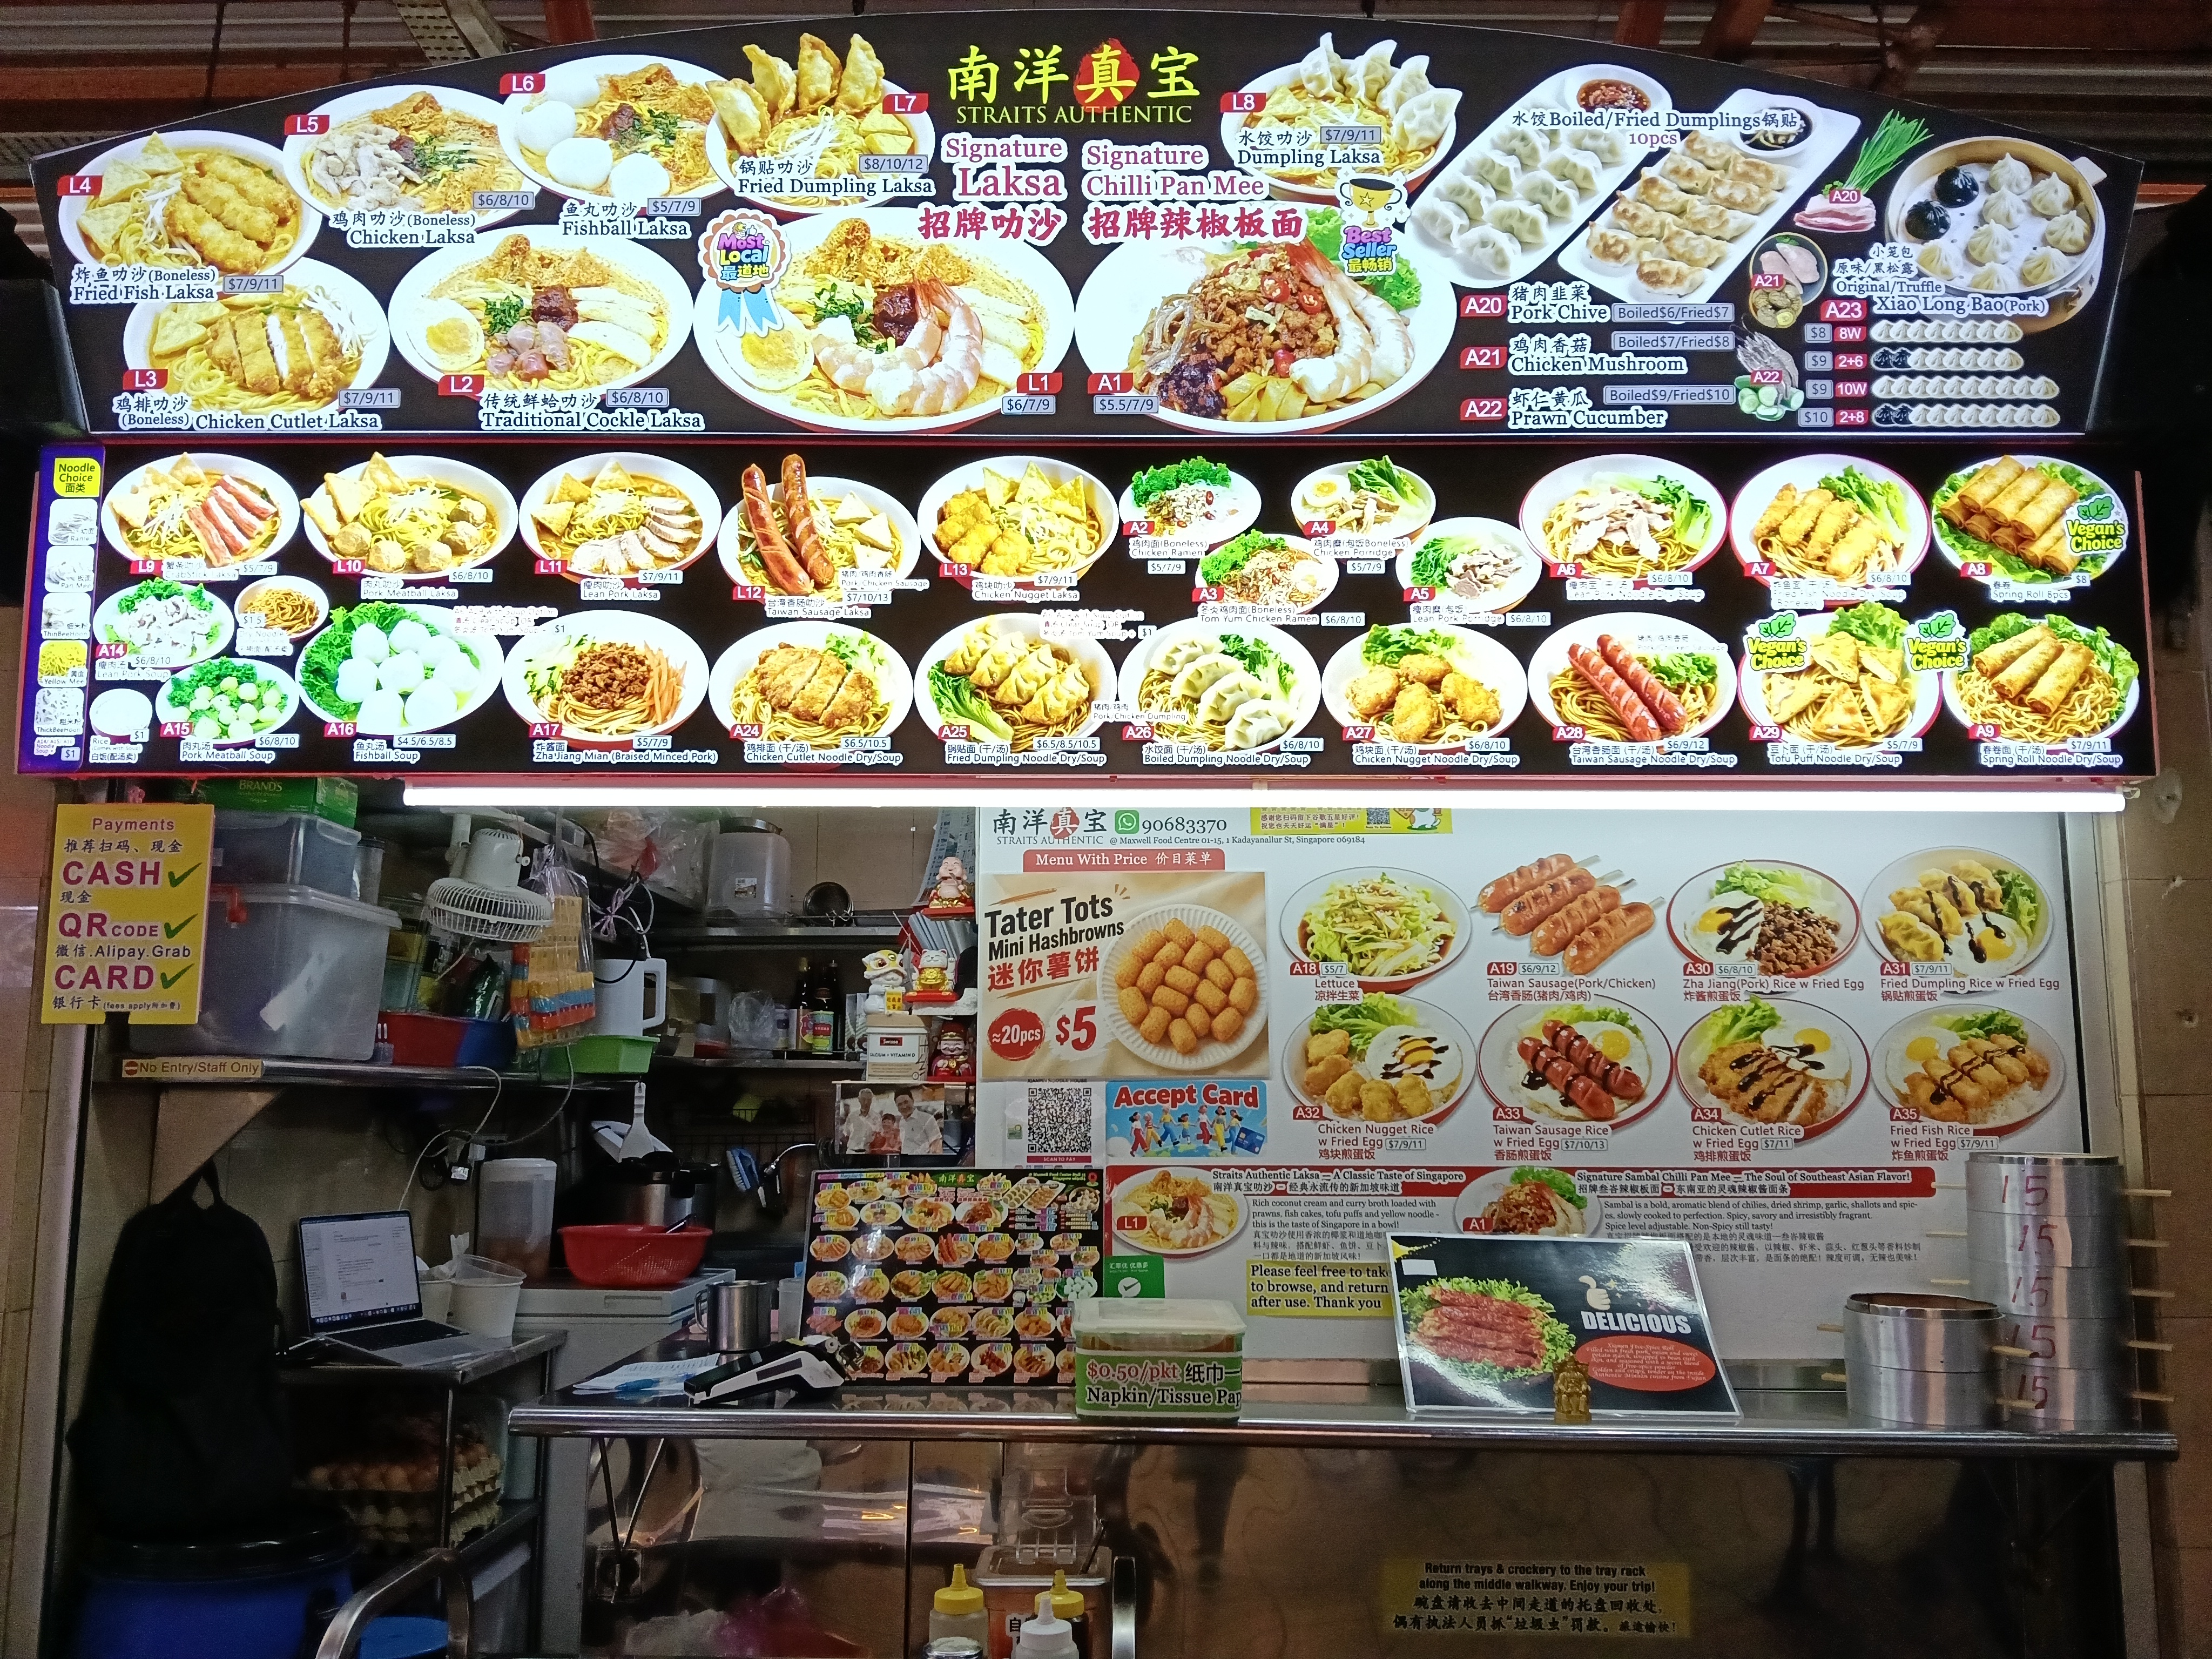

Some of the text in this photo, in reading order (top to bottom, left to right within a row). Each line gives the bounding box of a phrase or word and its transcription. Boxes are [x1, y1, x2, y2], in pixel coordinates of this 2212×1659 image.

[947, 44, 1200, 104] 南洋真宝
[512, 76, 534, 91] L6
[894, 96, 916, 111] L7
[1232, 93, 1255, 110] L8
[956, 105, 1192, 124] STRAITS AUTHENTIC
[1629, 133, 1677, 148] 10pcs
[946, 137, 1062, 163] Signature
[1087, 145, 1203, 170] Signature
[864, 157, 923, 171] $8/10/12
[1237, 150, 1380, 168] Dumpling Laksa
[739, 159, 813, 176] 锅贴叻沙
[738, 178, 933, 196] Fried Dumpling Laksa
[959, 165, 1062, 196] Laksa
[1087, 174, 1264, 195] Chilli Pan Mee
[565, 201, 637, 217] 鱼丸叻沙
[652, 200, 696, 213] $5/7/9
[562, 220, 688, 235] Fishball Laksa
[918, 206, 1062, 241] 招牌叻沙
[1089, 206, 1303, 240] 招牌辣椒板面
[717, 232, 765, 250] Most
[1344, 226, 1392, 244] Best
[719, 245, 770, 266] Local
[1342, 242, 1397, 259] Seller
[720, 264, 770, 281] 最道地
[1836, 281, 1942, 294] Original/Truffle
[1465, 297, 1502, 313] A20
[1512, 305, 1607, 319] Pork Chive
[1825, 302, 1862, 319] A23
[1028, 375, 1048, 390] L1
[1098, 375, 1122, 390] A1
[1007, 398, 1050, 412] $6/7/9
[1099, 398, 1154, 412] $5.5/7/9
[1465, 401, 1502, 417] A22
[1512, 410, 1664, 426] Prawn Cucumber
[1804, 412, 1864, 423] $10 2+8
[59, 463, 96, 473] Noodle
[59, 473, 93, 482] Choice
[65, 483, 85, 493] 面类
[2067, 521, 2125, 538] Vegan's
[2071, 535, 2122, 551] Choice
[1967, 563, 1985, 576] A8
[2075, 574, 2087, 584] $8
[1199, 589, 1217, 599] A3
[1993, 590, 2068, 601] Spring Roll 8pcs
[1246, 615, 1282, 623] Chicken
[1286, 615, 1317, 623] Ramen
[163, 723, 190, 735] A15
[259, 737, 296, 746] $6/8/10
[182, 751, 273, 762] Pork Meatball Soup
[92, 818, 174, 832] Payments
[1142, 817, 1227, 834] 90683370
[1110, 837, 1117, 845] @
[1120, 835, 1151, 844] Maxwell
[1154, 835, 1172, 844] Food
[1232, 835, 1282, 845] Kadayanallur
[1284, 835, 1294, 845] St,
[1296, 835, 1334, 845] Singapore
[1337, 836, 1365, 844] 069184
[1036, 852, 1212, 866] Menu With Price 价目菜单
[63, 861, 160, 885] CASH
[60, 891, 92, 904] 现金
[984, 894, 1113, 938] Tater Tots
[58, 913, 158, 938] QR CODE
[988, 921, 1124, 961] Mini Hashbrowns
[988, 946, 1100, 992] 迷你薯饼
[1293, 963, 1317, 974] A18
[1324, 965, 1344, 974] $5/7
[55, 965, 154, 989] CARD
[1315, 978, 1355, 989] Lettuce
[1314, 989, 1360, 1002] 凉拌生菜
[1056, 1006, 1096, 1051] $5
[140, 1061, 259, 1075] No Entry/Staff Only
[1115, 1083, 1258, 1108] Accept Card
[1893, 1108, 1918, 1120] A35
[1891, 1125, 1971, 1136] Fried Fish Rice
[1891, 1138, 1995, 1150] w Fried Egg $7/9/11
[1212, 1170, 1464, 1182] Straits Authentic Laksa A Classic Taste of Singapore
[2001, 1175, 2048, 1206] 15
[1251, 1264, 1291, 1277] Please
[1294, 1265, 1317, 1278] feel
[1321, 1265, 1344, 1278] free
[1348, 1267, 1362, 1278] to
[1251, 1280, 1388, 1295] to browse, and return
[1251, 1297, 1381, 1311] after use. Thank you
[1581, 1311, 1691, 1334] DELICIOUS
[1087, 1362, 1178, 1382] $0.50/pkt
[1087, 1388, 1211, 1407] Napkin/Tissue
[1425, 1562, 1646, 1577] Return trays & crockery to the tray rack
